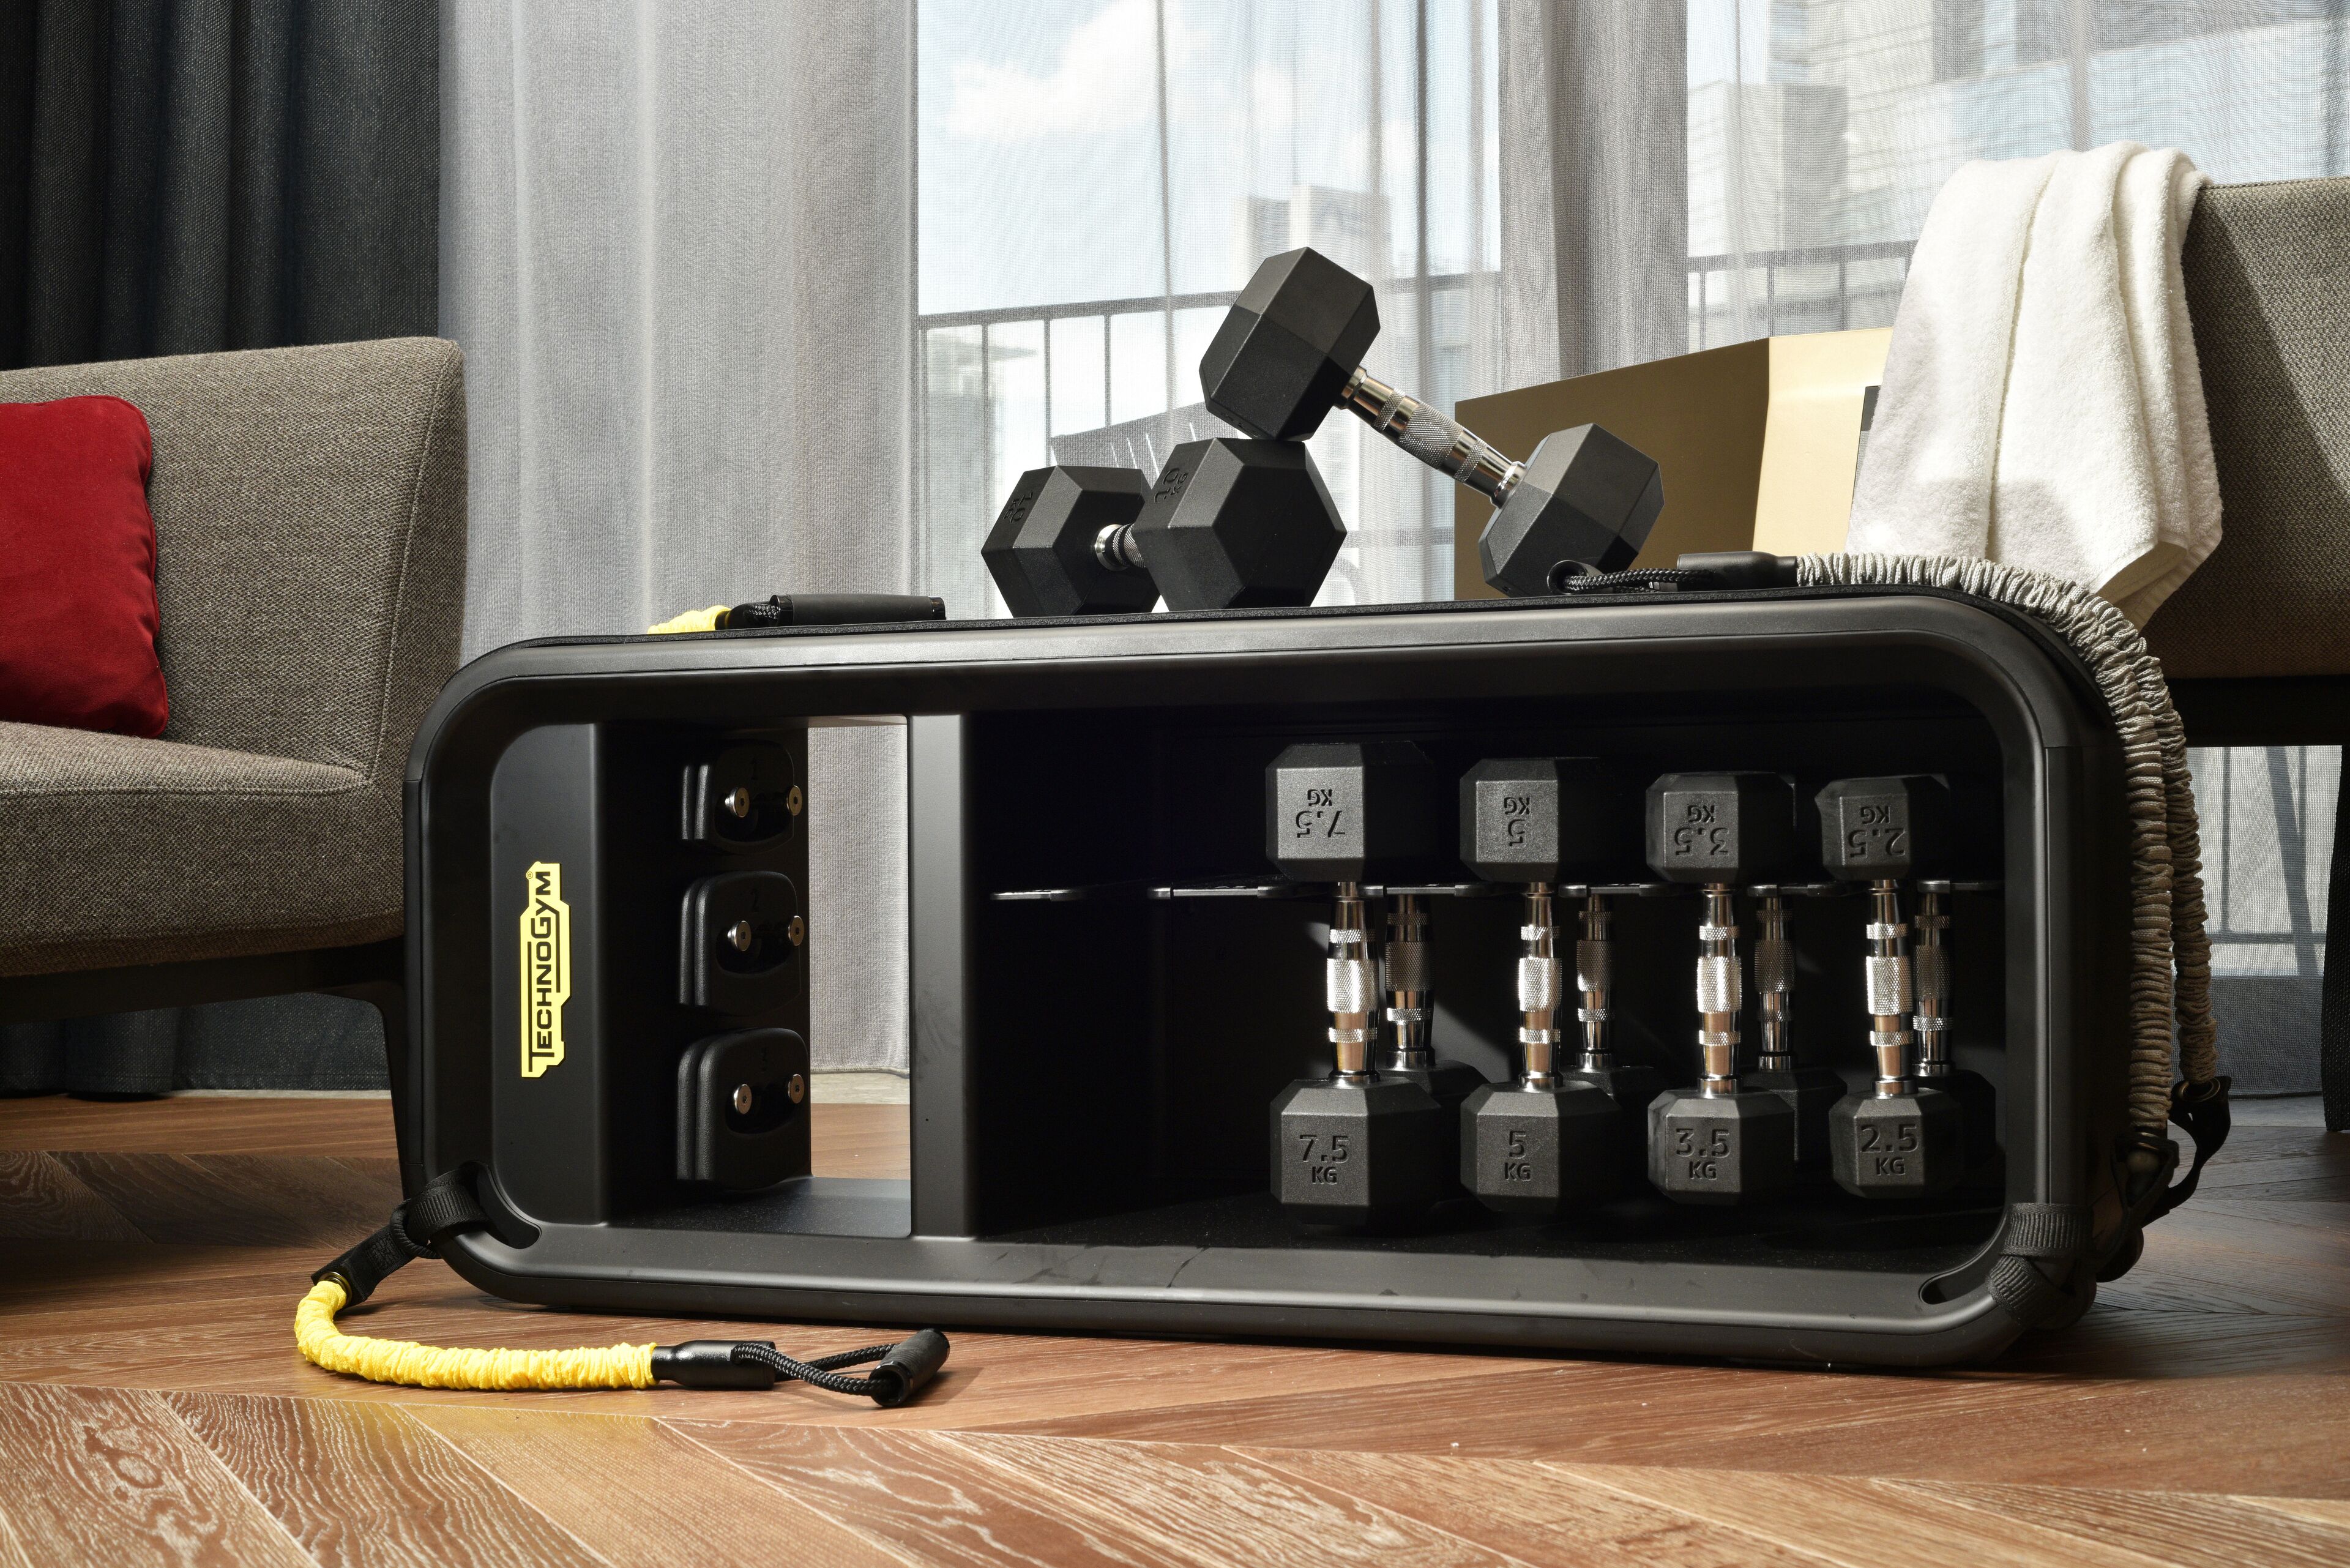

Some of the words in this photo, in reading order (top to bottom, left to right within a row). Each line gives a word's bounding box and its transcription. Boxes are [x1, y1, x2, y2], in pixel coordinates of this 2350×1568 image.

[1307, 789, 1333, 807] KG
[1503, 796, 1531, 815] KG
[1296, 810, 1346, 838] 7.5
[1687, 804, 1716, 823] KG
[1860, 805, 1890, 825] KG
[1507, 818, 1524, 847] 5
[1674, 827, 1730, 856] 3.5
[1848, 827, 1907, 859] 2.5
[528, 871, 560, 1073] TECHNOGYM
[1299, 1134, 1349, 1163] 7.5
[1507, 1130, 1527, 1160] 5
[1674, 1127, 1731, 1159] 3.5
[1860, 1122, 1920, 1154] 2.5
[1311, 1166, 1338, 1185] KG
[1503, 1162, 1532, 1182] KG
[1688, 1160, 1718, 1181] KG
[1875, 1157, 1907, 1177] KG
